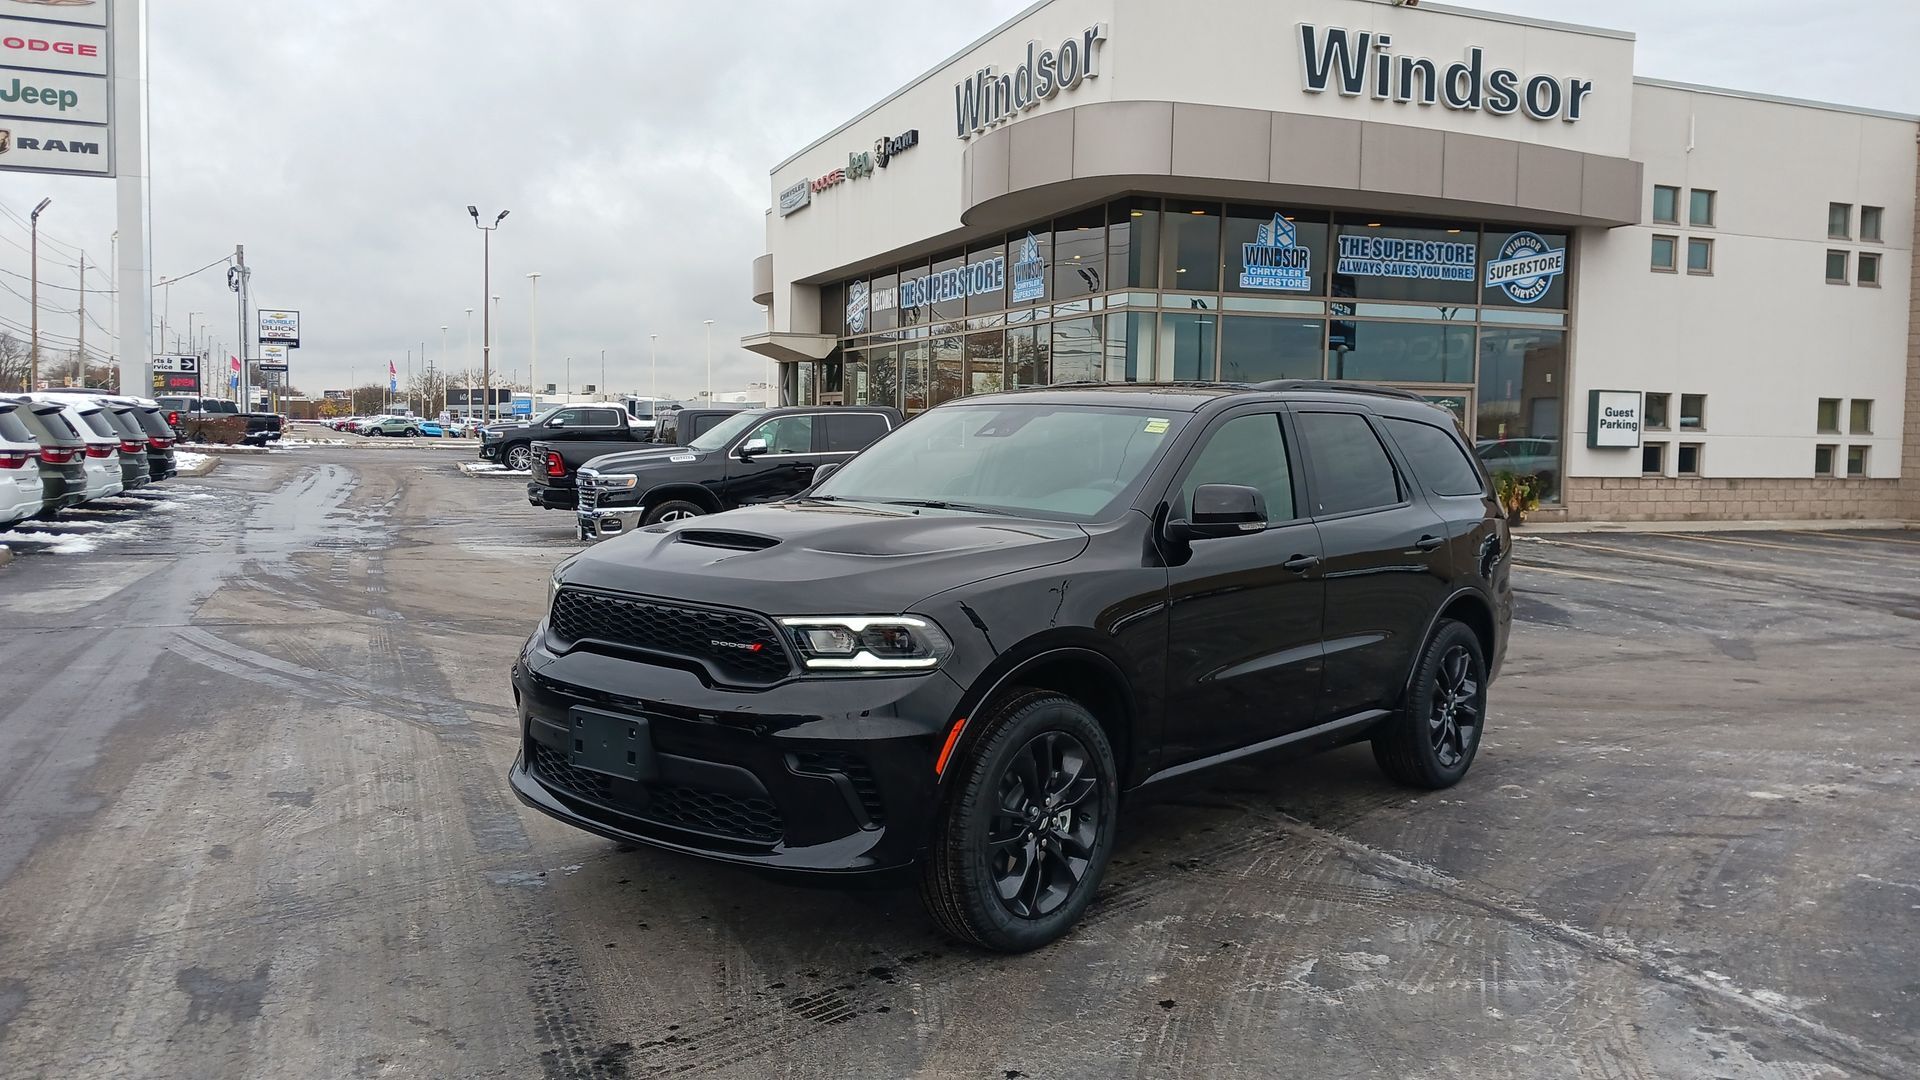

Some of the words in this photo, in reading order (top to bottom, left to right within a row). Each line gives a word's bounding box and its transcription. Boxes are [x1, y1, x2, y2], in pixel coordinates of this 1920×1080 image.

[0, 37, 97, 57] ODGE
[955, 23, 1106, 140] Windsor
[1296, 23, 1593, 122] Windsor
[0, 78, 78, 111] Jeep
[17, 137, 99, 155] RAM
[884, 129, 919, 156] RAM
[811, 168, 845, 193] DODGE
[780, 182, 806, 202] CHRYSLER
[1340, 237, 1371, 257] THE
[1373, 239, 1475, 264] SUPERSTORE
[1505, 237, 1542, 256] WINDSOR
[1244, 246, 1308, 268] WINDSOR
[1249, 267, 1302, 277] CHRYSLER
[1339, 260, 1381, 275] ALWAYS
[1384, 262, 1418, 277] SAVES
[1420, 265, 1440, 279] YOU
[1441, 267, 1474, 280] MORE!
[1489, 256, 1561, 280] SUPERSTORE
[901, 282, 915, 308] THE
[917, 261, 1003, 306] SUPERSTORE
[1242, 276, 1308, 288] SUPERSTORE
[1510, 278, 1547, 299] CHRYSLER
[1604, 406, 1634, 418] Guest
[1600, 418, 1638, 432] Parking
[711, 640, 755, 650] DODGE
